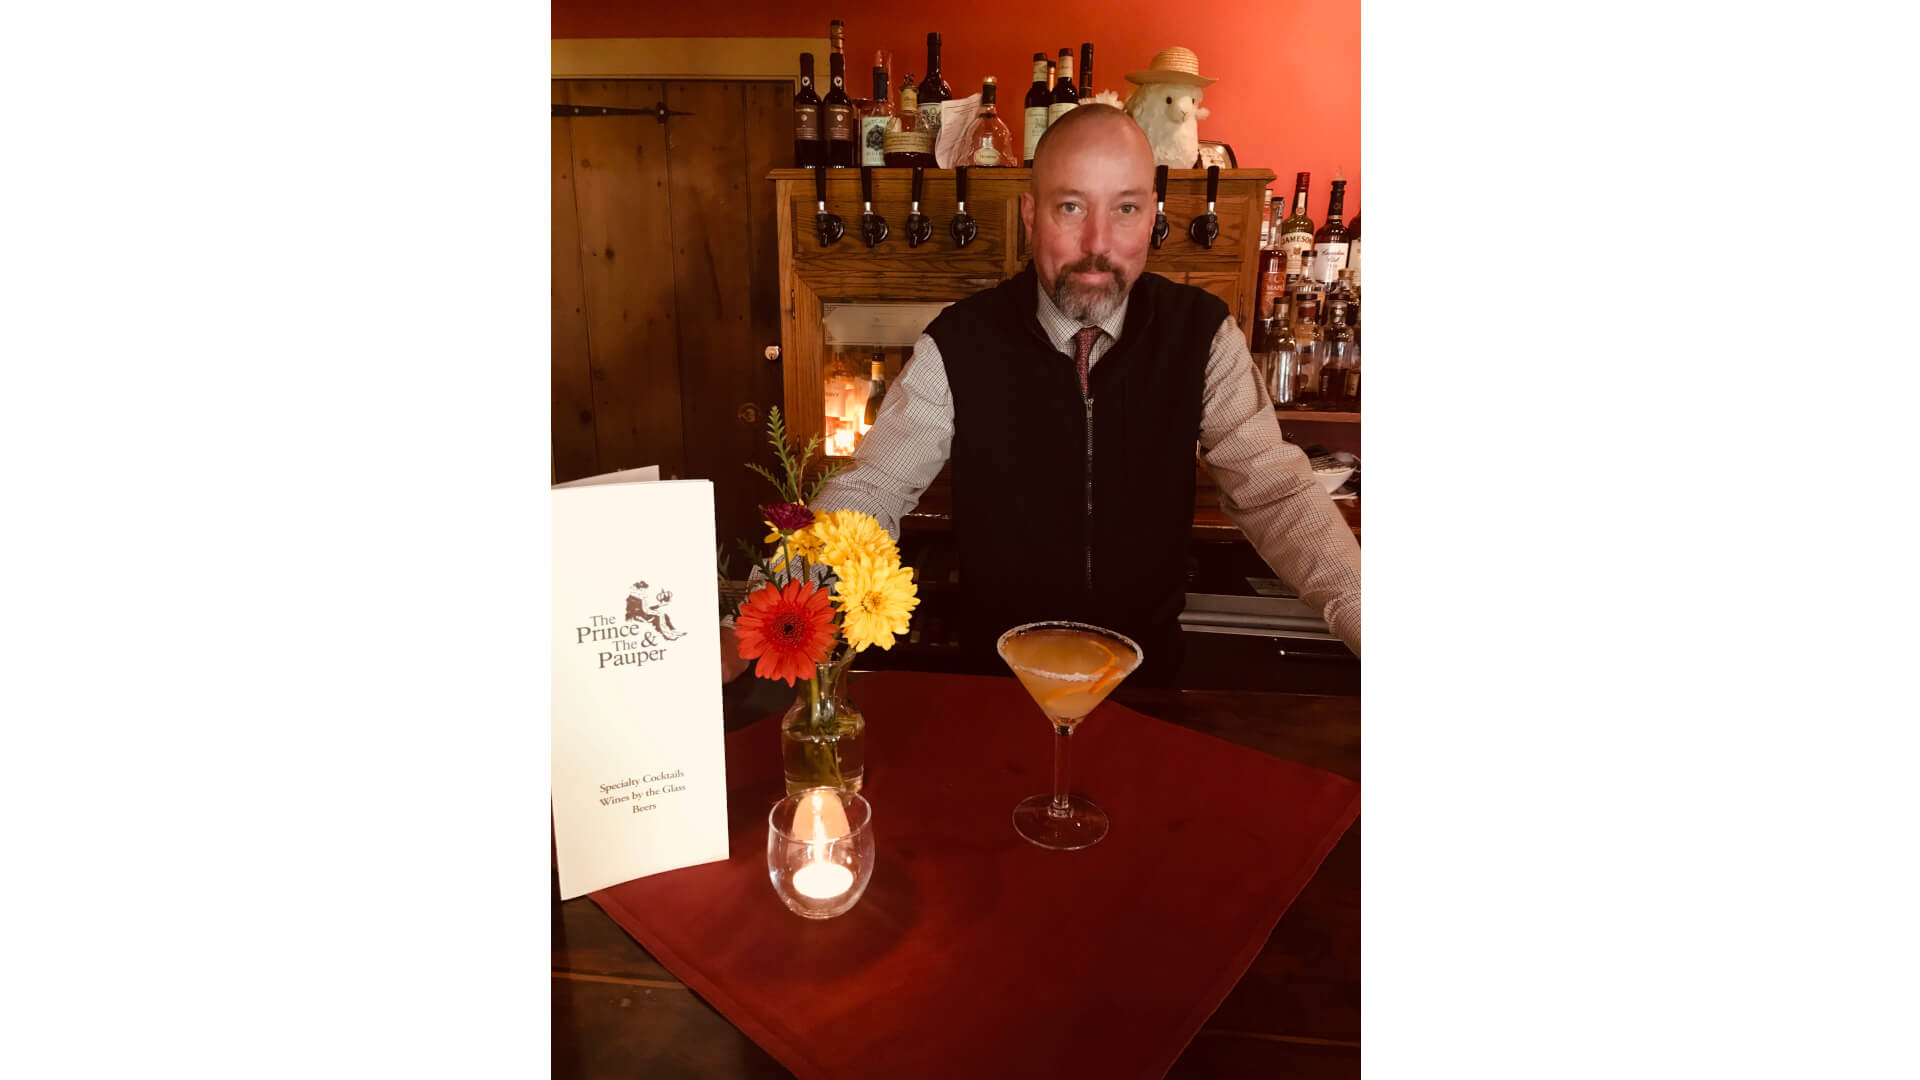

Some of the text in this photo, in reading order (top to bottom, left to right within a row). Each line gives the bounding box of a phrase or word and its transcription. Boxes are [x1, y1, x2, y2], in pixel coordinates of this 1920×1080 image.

[590, 615, 616, 627] The
[576, 624, 639, 643] Prince
[612, 631, 657, 651] The &
[598, 649, 667, 668] Pauper
[599, 769, 684, 794] Specialty Cocktails
[599, 784, 686, 807] Wines by the Glass
[632, 804, 656, 813] Beers
